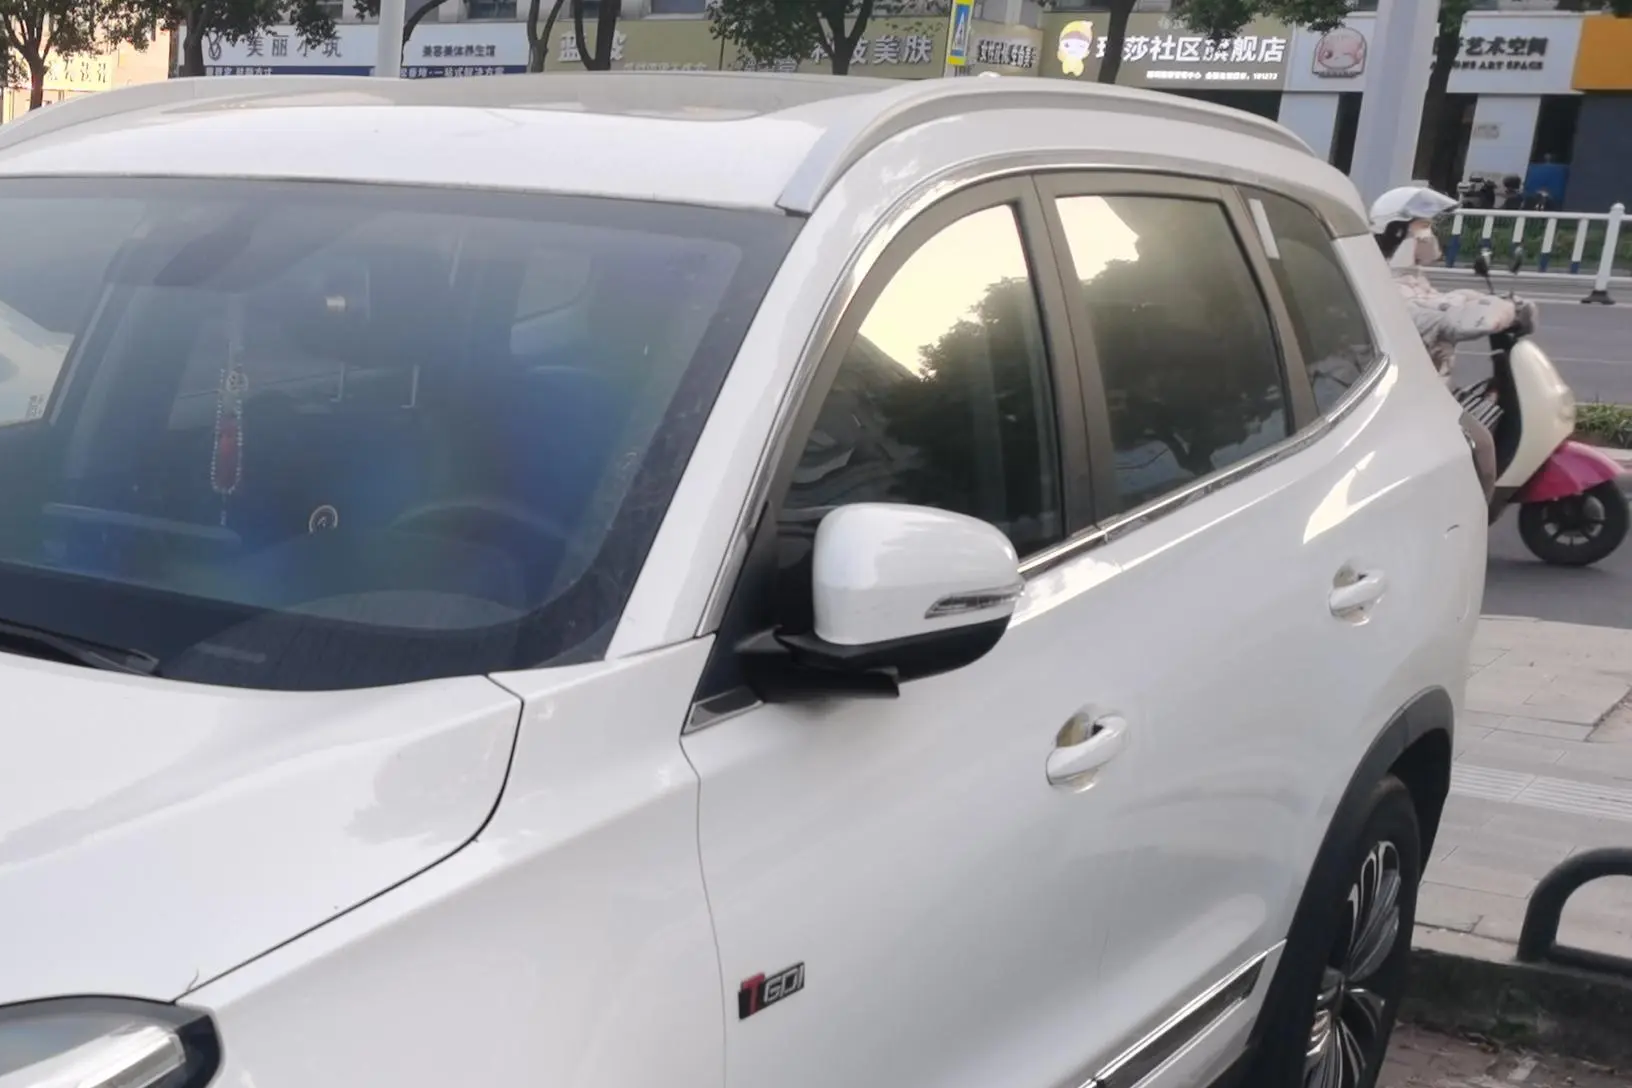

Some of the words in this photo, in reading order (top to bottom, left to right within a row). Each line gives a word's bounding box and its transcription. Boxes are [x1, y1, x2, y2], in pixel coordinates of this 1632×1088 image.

[1096, 35, 1287, 62] 莎社区旗舰店
[1432, 36, 1548, 57] 艺术空间
